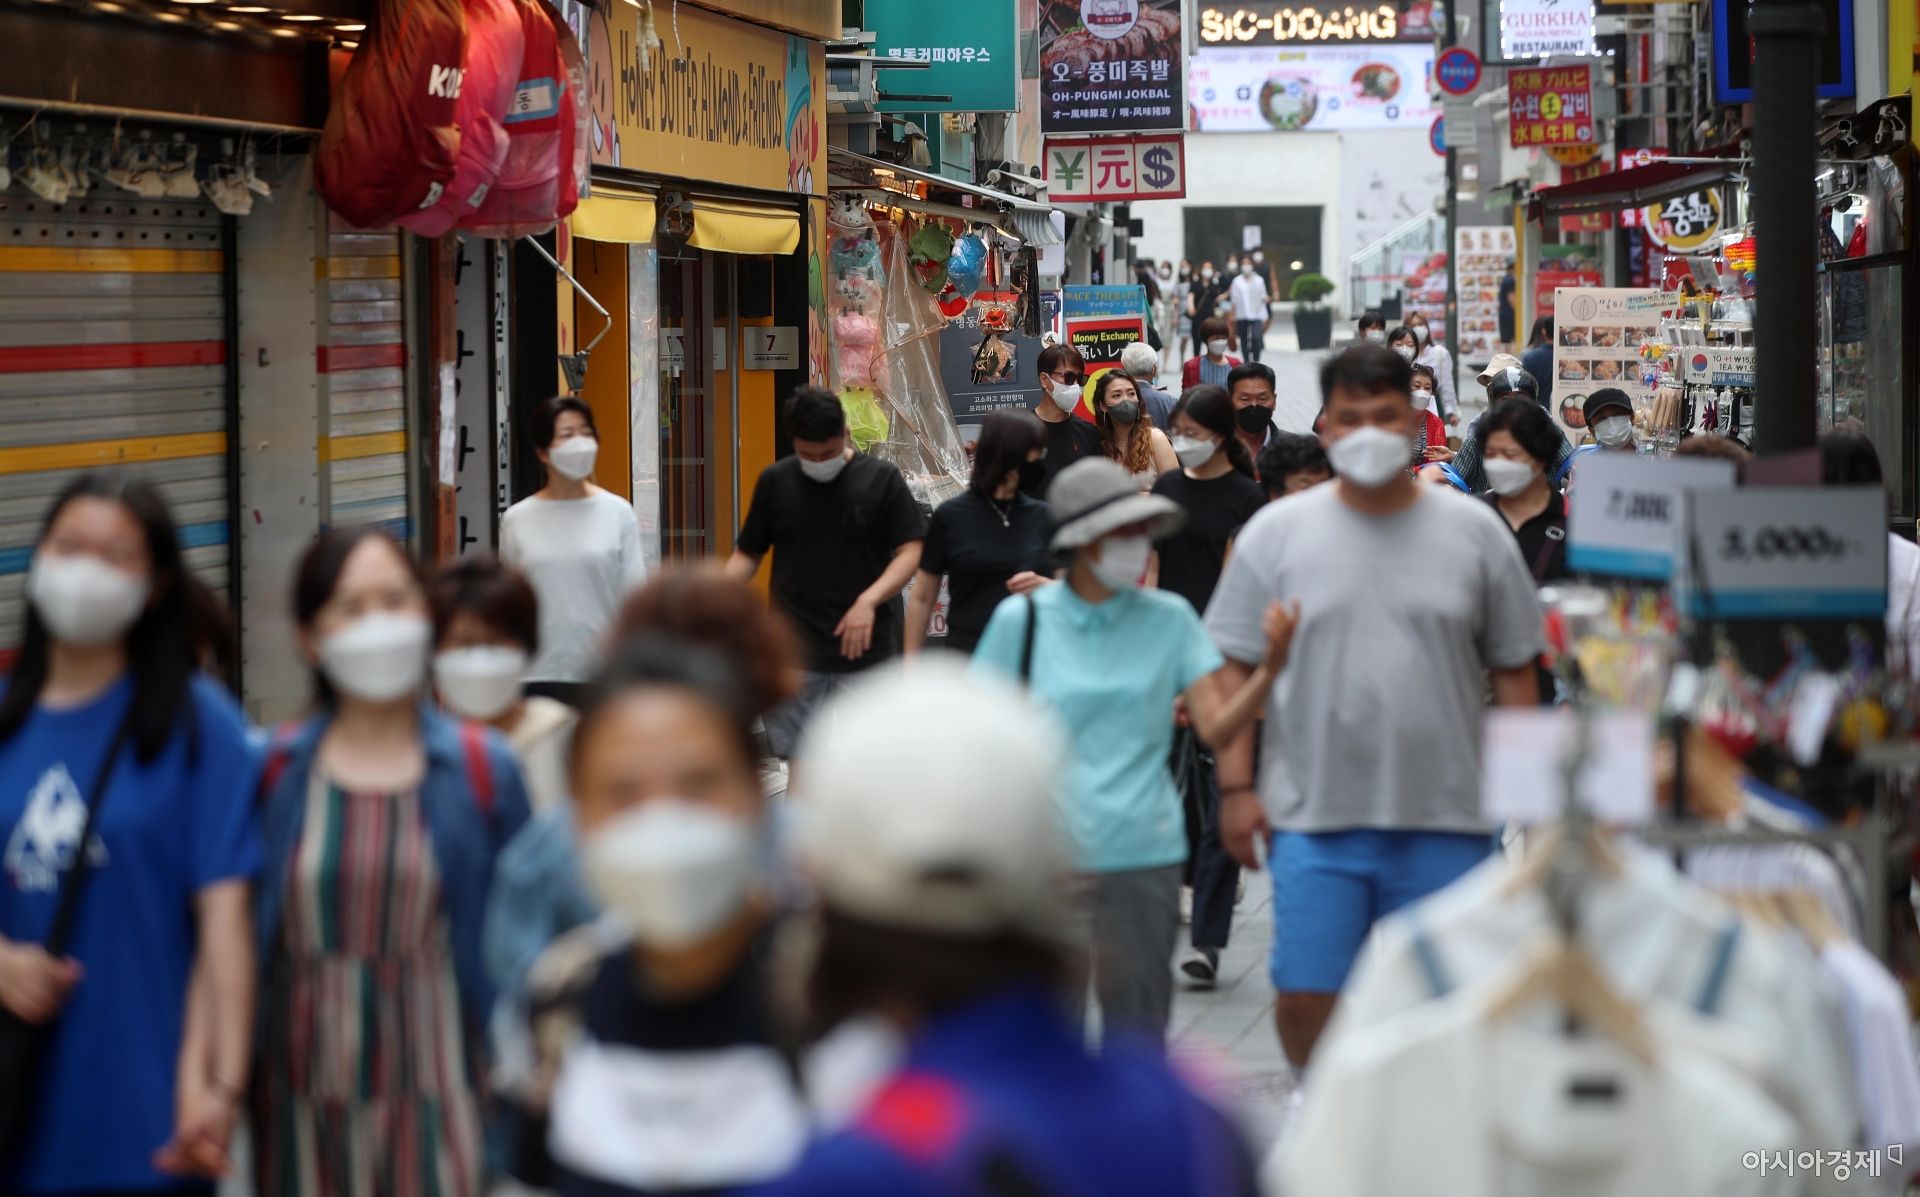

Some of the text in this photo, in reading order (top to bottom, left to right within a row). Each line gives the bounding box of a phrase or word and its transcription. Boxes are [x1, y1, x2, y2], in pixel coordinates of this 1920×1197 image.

[1506, 12, 1588, 28] GURKHA
[1512, 40, 1584, 52] RESTAURANT
[1052, 88, 1171, 102] OH-PUNGMI JOKBAL
[1097, 149, 1132, 190] 元
[1142, 145, 1176, 190] $
[766, 334, 776, 351] 7
[1072, 332, 1139, 344] Money Exchange
